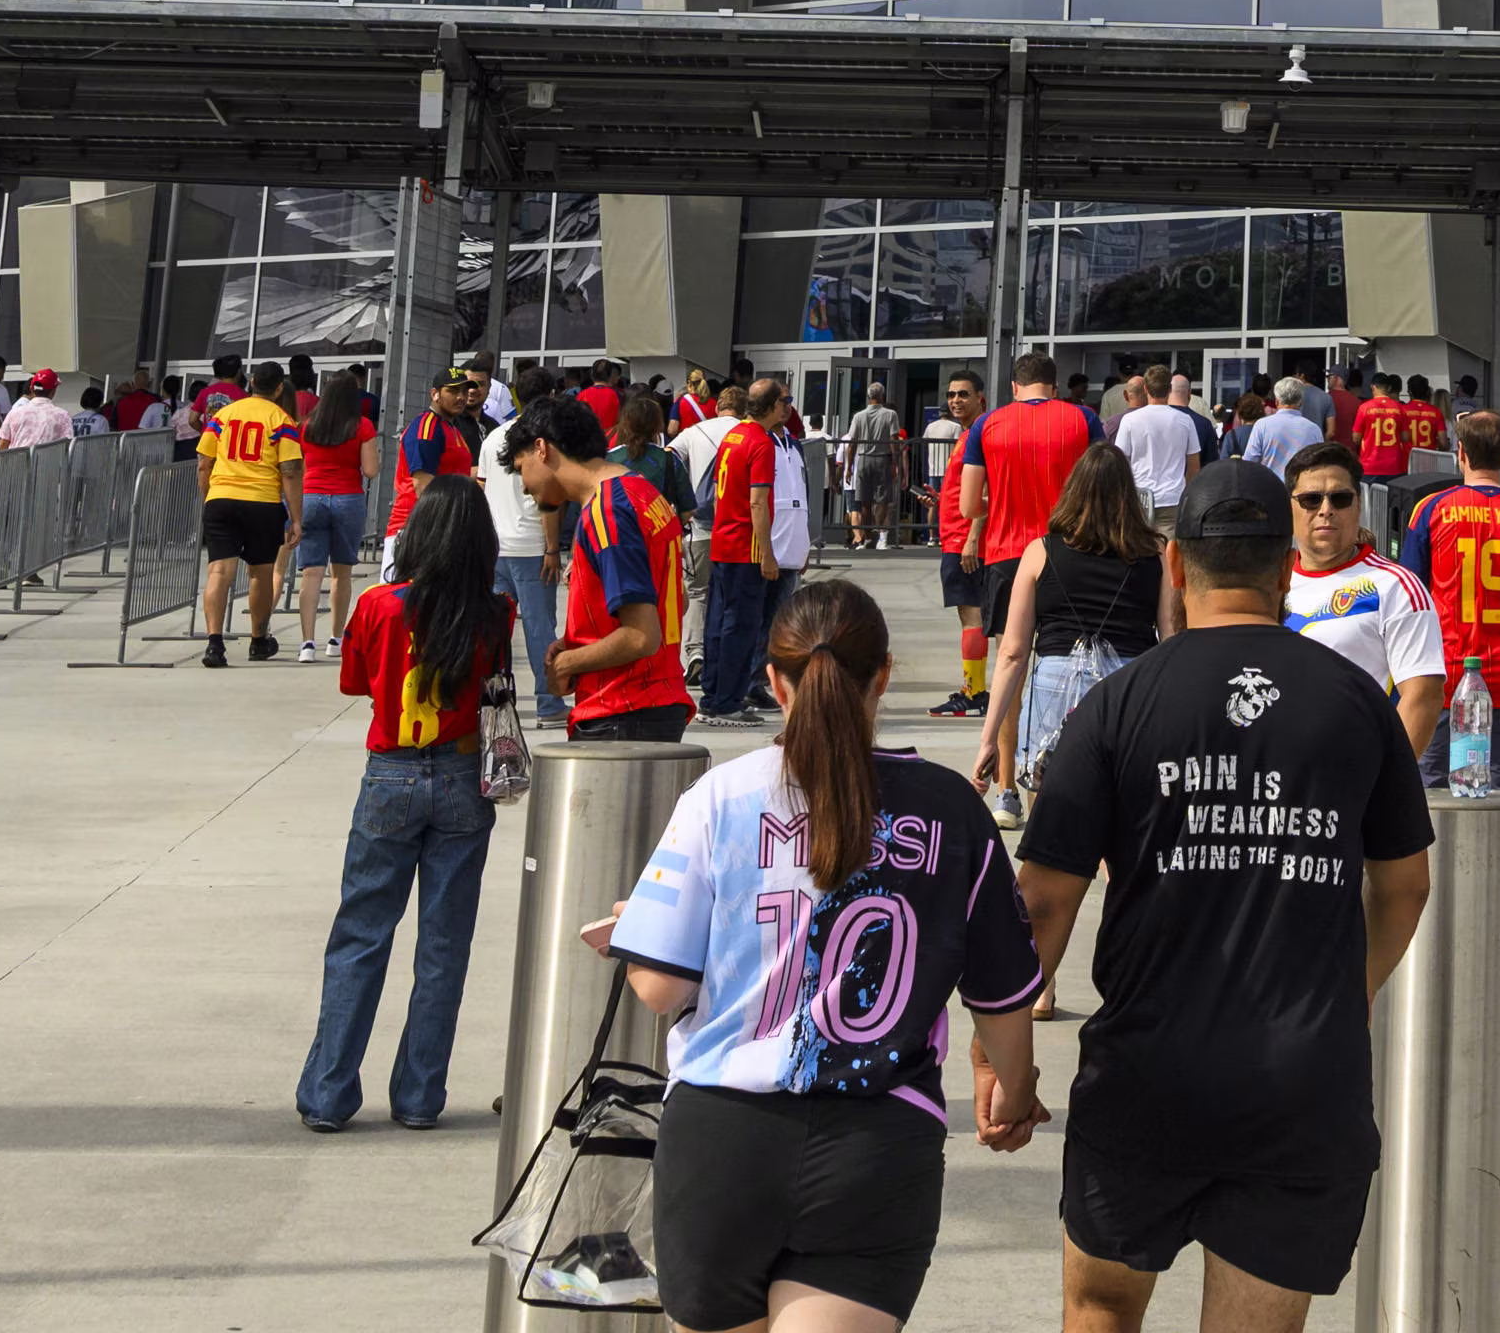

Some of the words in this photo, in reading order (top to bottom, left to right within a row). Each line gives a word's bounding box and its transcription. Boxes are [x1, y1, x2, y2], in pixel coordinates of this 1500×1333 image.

[227, 419, 264, 462] 10
[1371, 418, 1397, 447] 19
[1409, 419, 1431, 447] 19
[1442, 506, 1491, 524] LAMINE
[1157, 755, 1237, 797] PAIN
[1252, 771, 1281, 801] IS
[1187, 804, 1339, 840] WEAKNESS
[758, 811, 942, 876] MSSI
[1248, 846, 1277, 865] THE
[1280, 854, 1345, 886] BODY.
[753, 888, 919, 1045] 10
